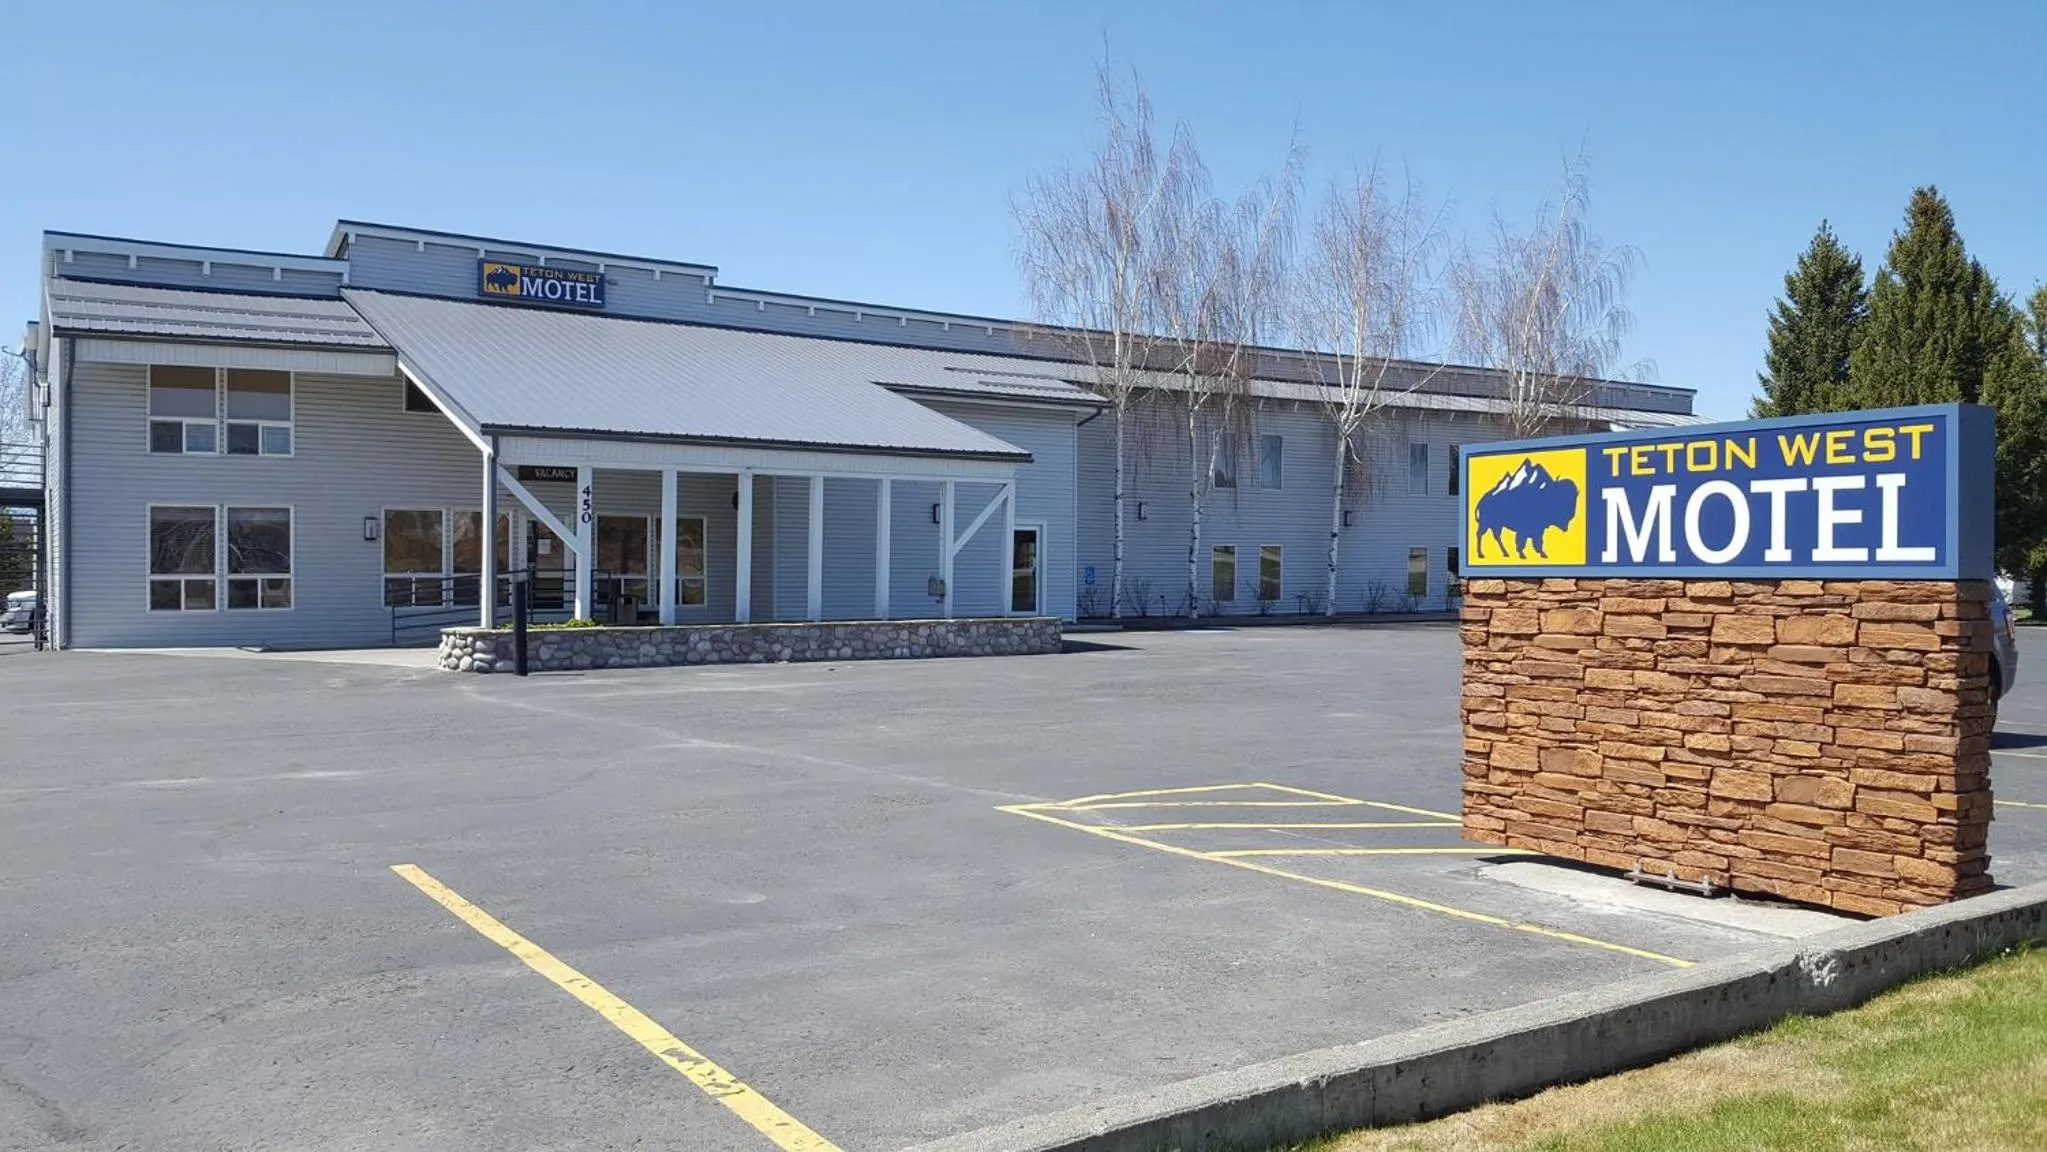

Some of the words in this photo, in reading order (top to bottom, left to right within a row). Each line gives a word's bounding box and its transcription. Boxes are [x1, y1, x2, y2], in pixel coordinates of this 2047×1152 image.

[522, 267, 563, 279] TETON
[567, 272, 601, 282] WEST
[522, 277, 603, 303] MOTEL
[1602, 436, 1756, 477] TETON
[1778, 424, 1935, 468] WEST
[534, 467, 576, 479] VACANCY
[581, 485, 592, 524] 450
[1601, 472, 1936, 565] MOTEL
